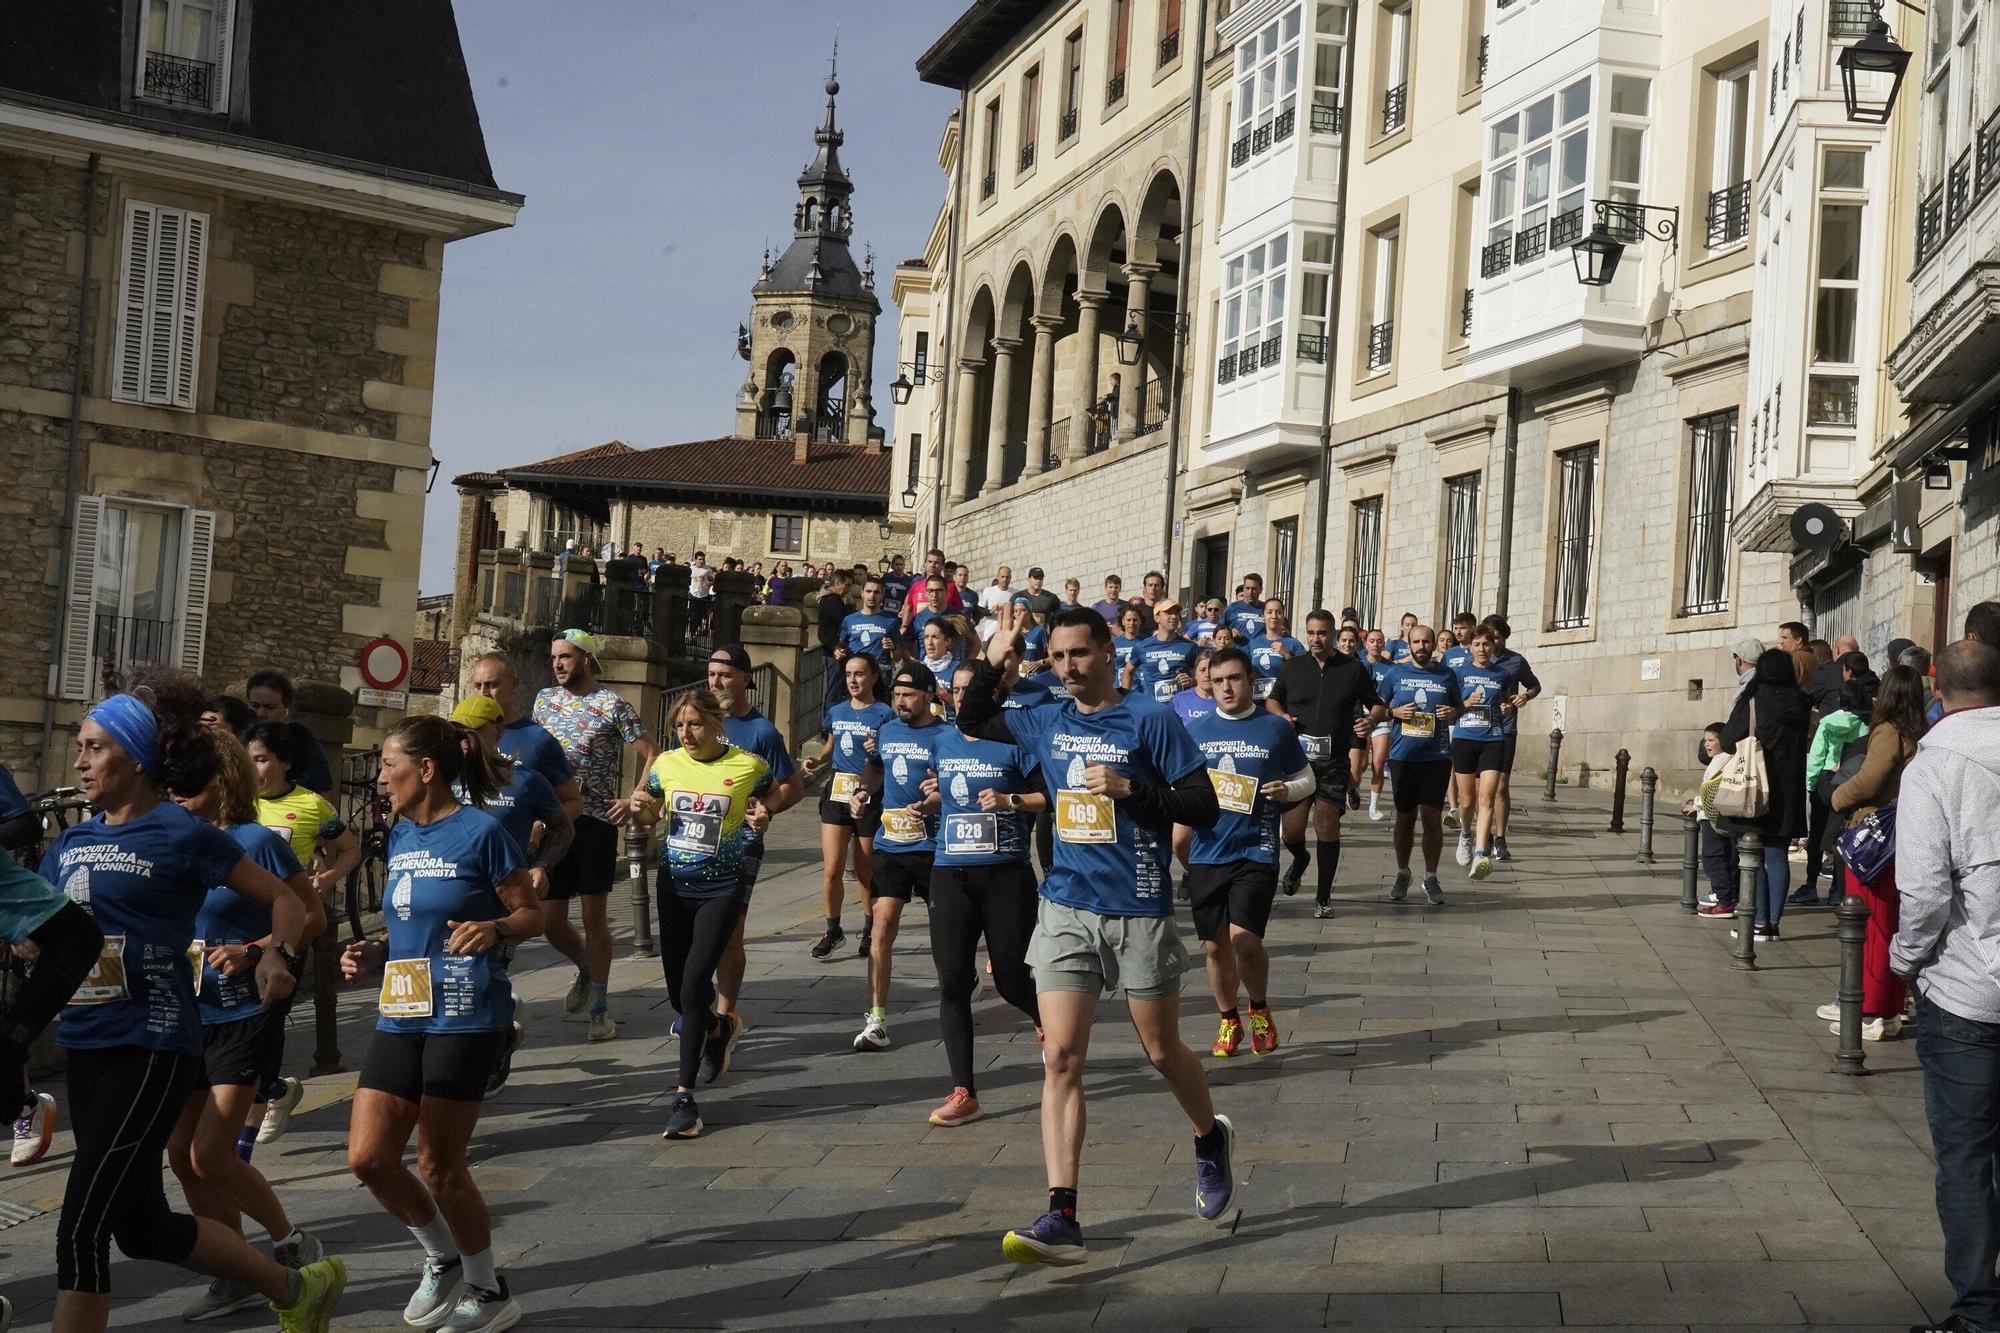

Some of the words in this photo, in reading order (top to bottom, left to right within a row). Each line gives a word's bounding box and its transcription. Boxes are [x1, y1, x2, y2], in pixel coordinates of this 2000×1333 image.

[1923, 573, 1930, 584] 2
[1161, 684, 1178, 694] 1014
[1054, 733, 1062, 741] LA
[1061, 734, 1102, 745] CONQUISTA
[1206, 740, 1246, 748] CONQUISTA
[1060, 741, 1117, 754] ALMENDRA
[1207, 745, 1260, 753] ALMENDRA
[1086, 753, 1129, 764] KONKISTA
[943, 763, 993, 772] ALMENDRA
[1217, 780, 1243, 798] 263
[1067, 803, 1097, 824] 469
[682, 820, 706, 839] 749
[891, 817, 912, 830] 522
[956, 823, 983, 839] 828
[67, 844, 120, 857] CONQUISTA
[62, 852, 137, 868] ALMENDRA
[136, 859, 154, 869] REN
[391, 857, 444, 871] ALMENDRA
[92, 862, 152, 878] KONKISTA
[413, 869, 457, 878] KONKISTA
[390, 974, 413, 997] 601
